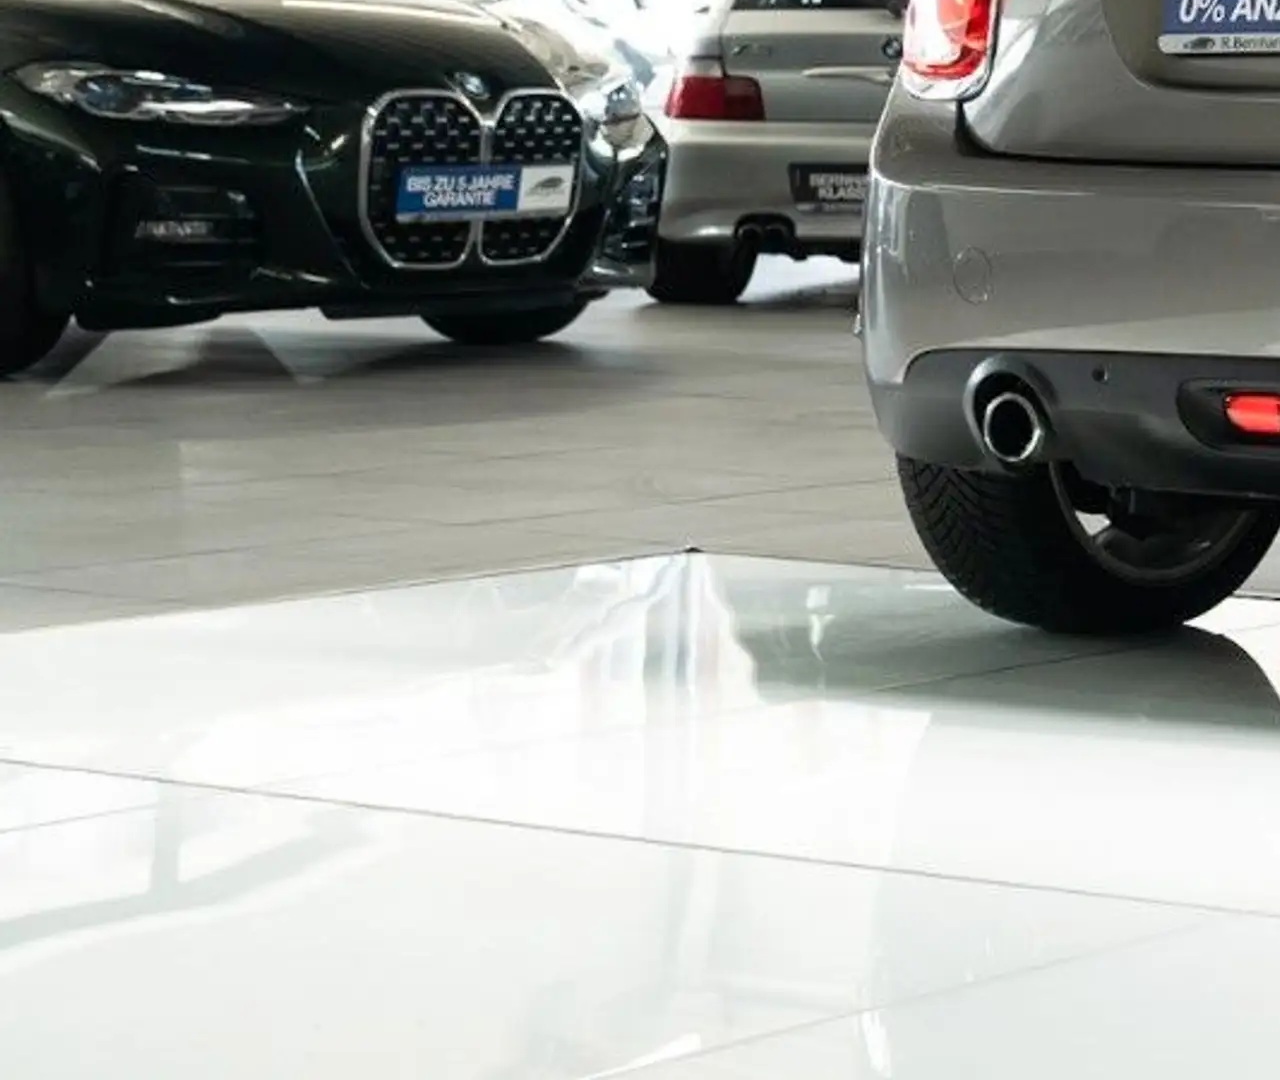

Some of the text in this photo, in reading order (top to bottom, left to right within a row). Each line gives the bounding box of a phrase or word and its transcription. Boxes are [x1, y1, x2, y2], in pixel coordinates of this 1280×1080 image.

[407, 175, 432, 192] BIS
[434, 175, 456, 191] ZU
[467, 173, 515, 190] JAHRE
[422, 189, 496, 208] GARANTIE
